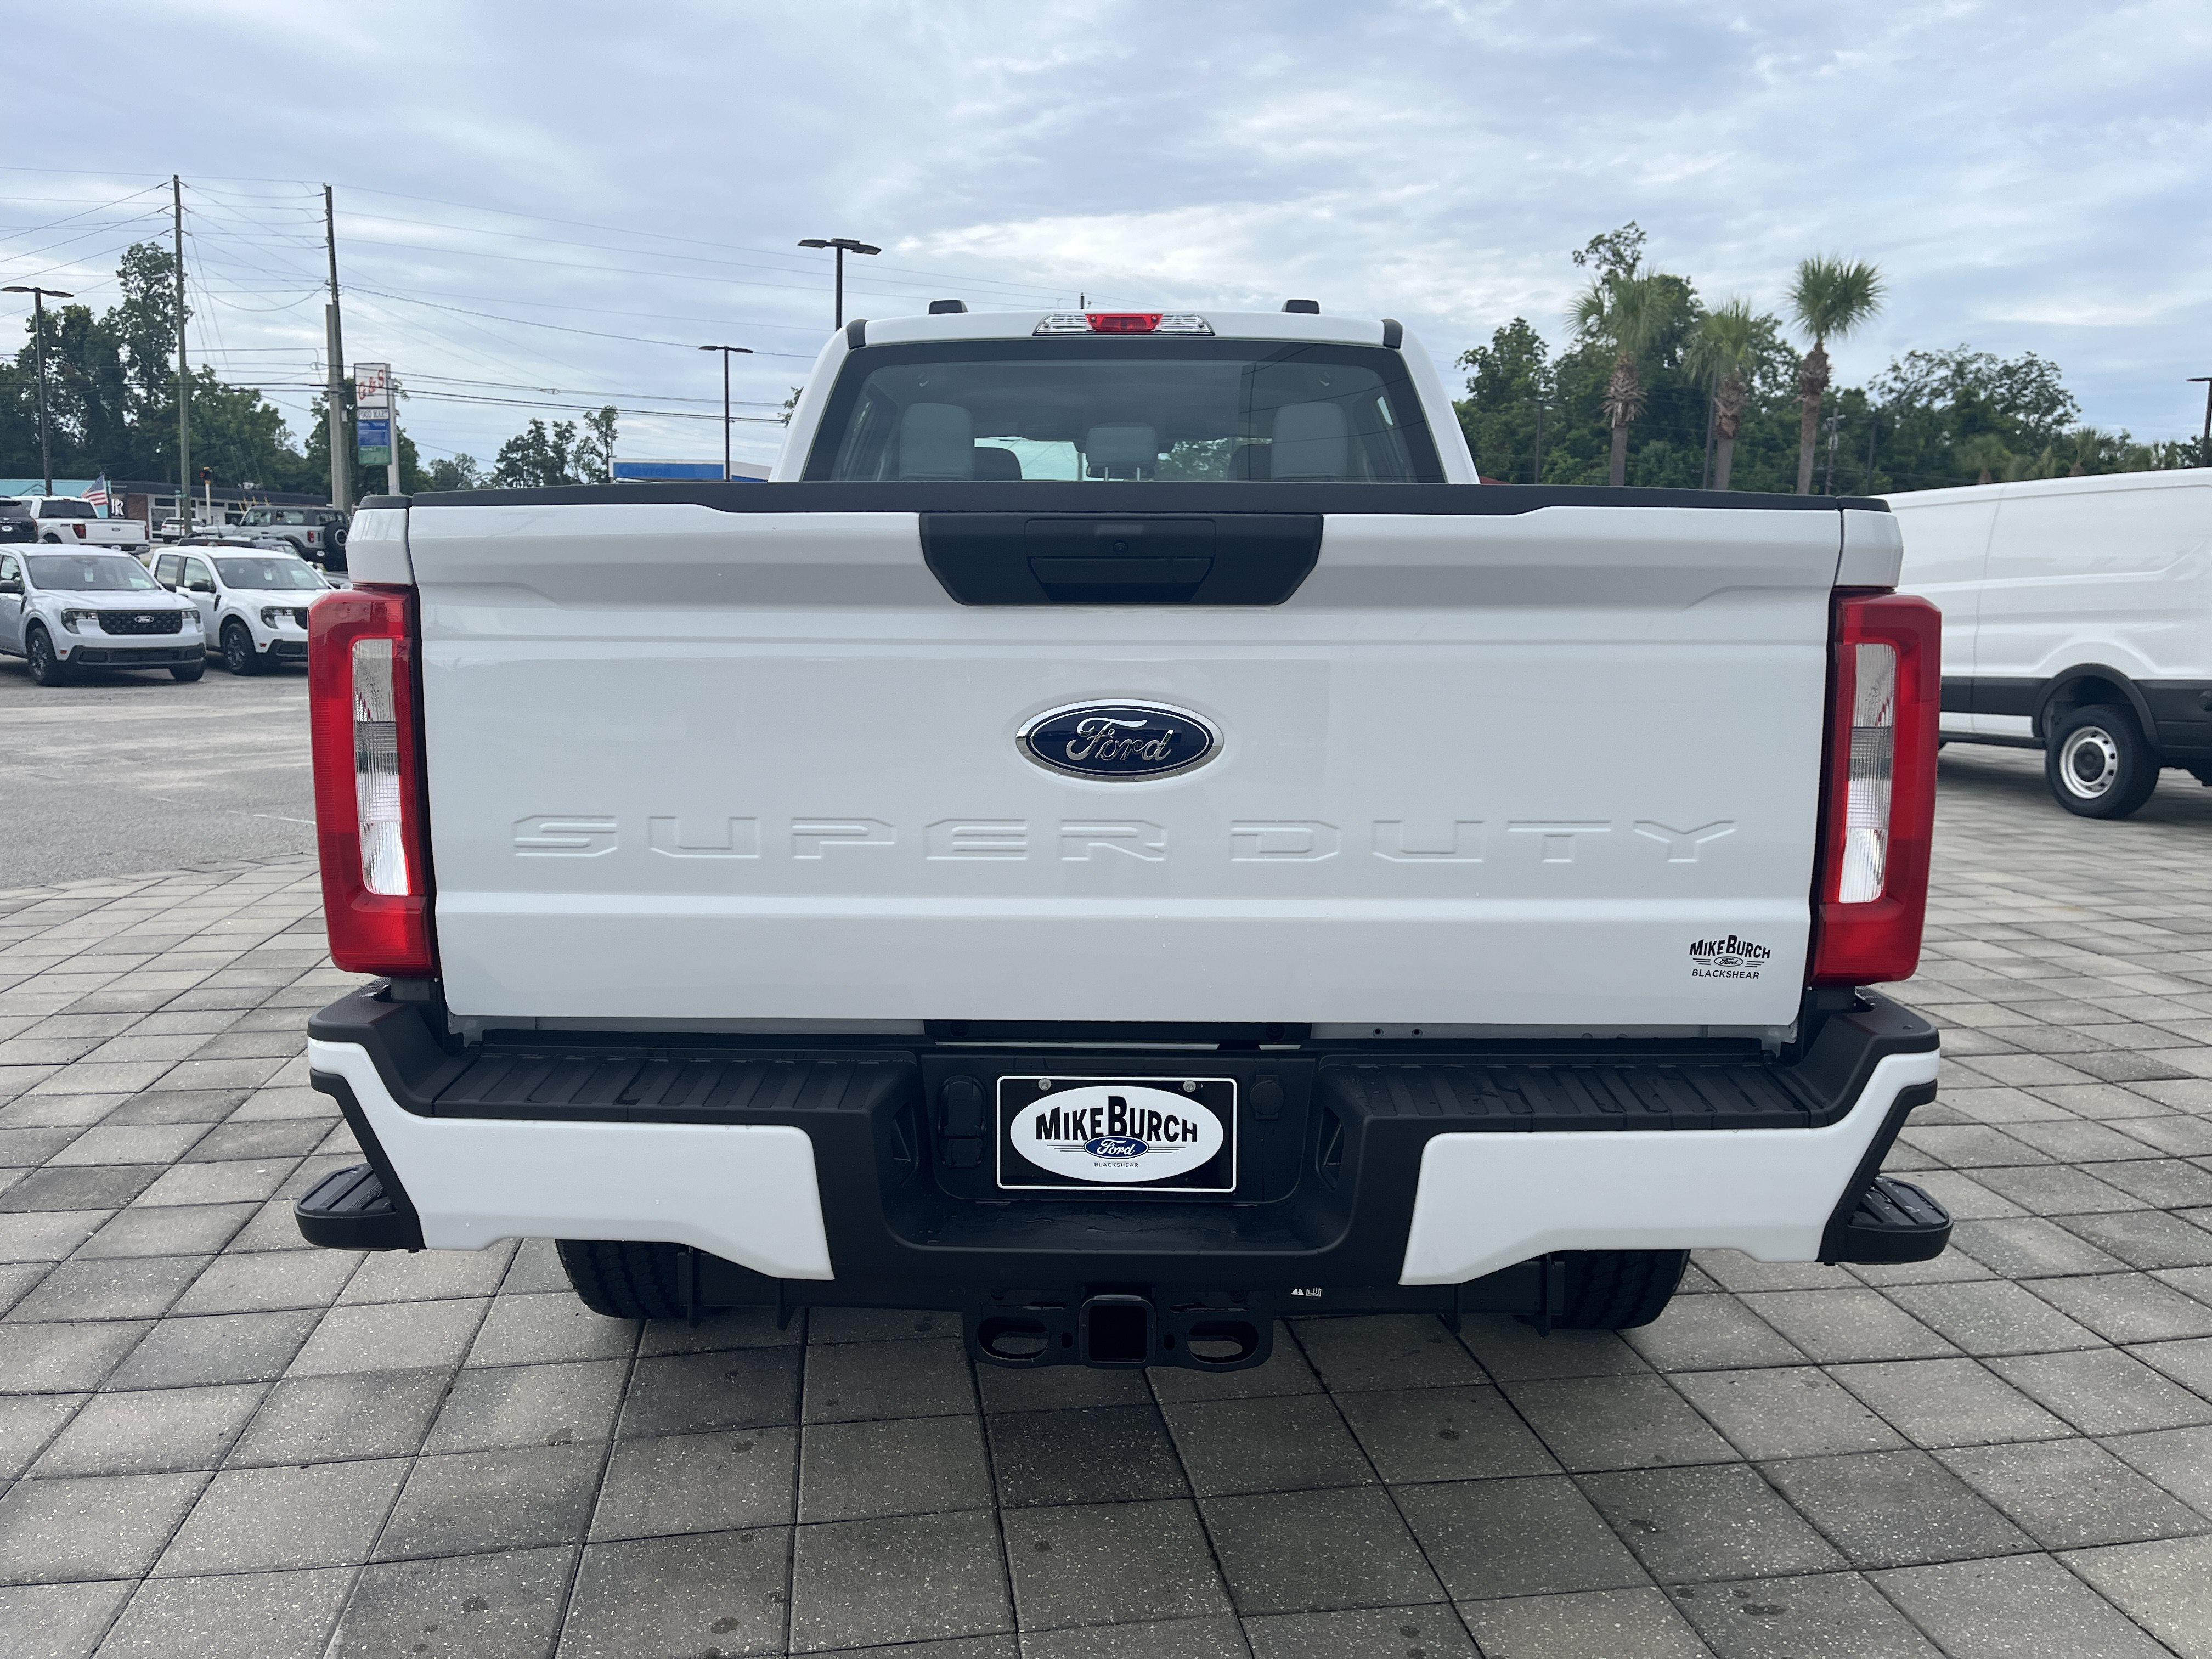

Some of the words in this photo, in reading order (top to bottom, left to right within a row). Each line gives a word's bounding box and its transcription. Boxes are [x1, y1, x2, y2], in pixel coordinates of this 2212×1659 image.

[1066, 717, 1174, 761] Ford
[512, 815, 1167, 862] SUPER
[1231, 819, 1737, 864] DUTY
[1692, 969, 1759, 979] BLACKSHEAR
[1097, 1139, 1135, 1155] Ford
